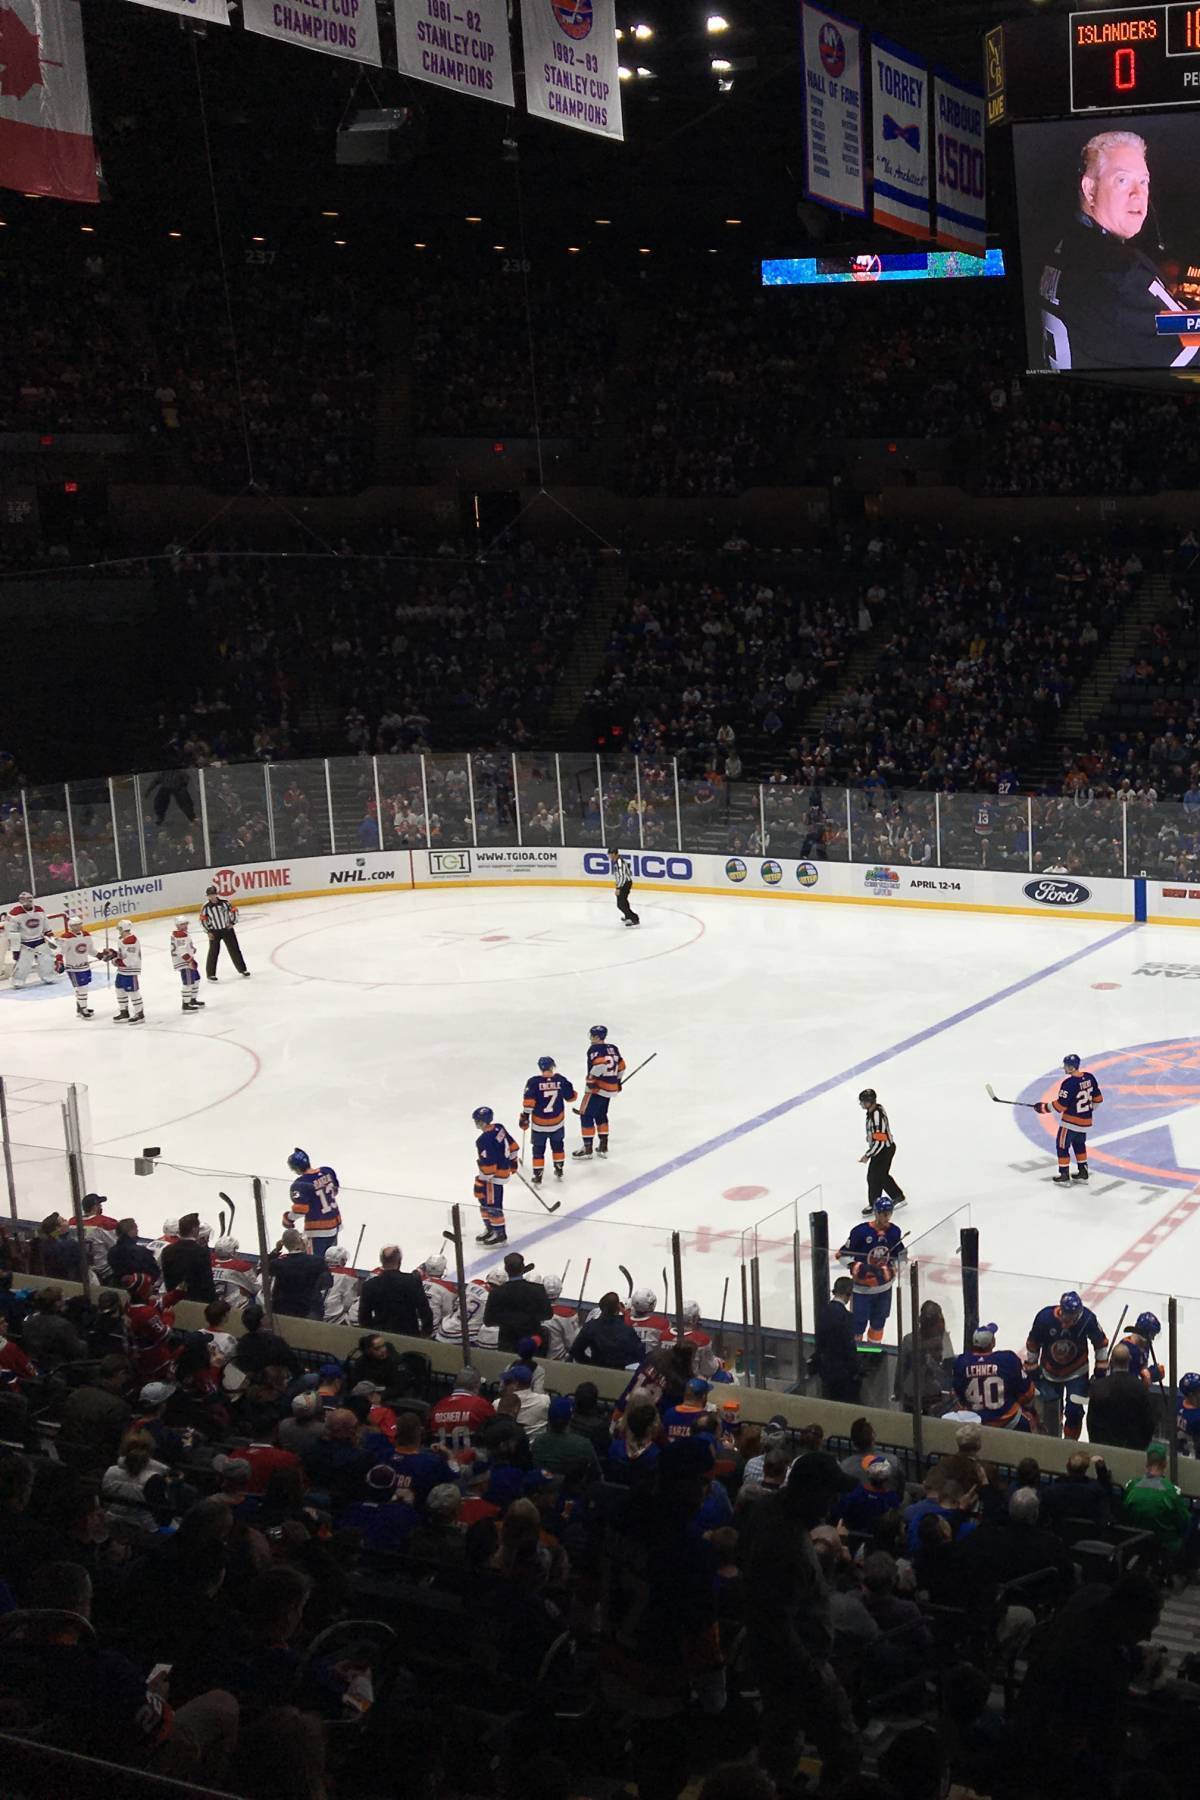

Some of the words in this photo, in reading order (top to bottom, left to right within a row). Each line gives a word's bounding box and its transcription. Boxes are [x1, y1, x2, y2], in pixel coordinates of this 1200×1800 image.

[272, 3, 357, 48] CHAMPIONS
[417, 20, 470, 58] STANLEY
[472, 38, 495, 64] CUP
[1077, 20, 1157, 44] ISLANDERS
[422, 50, 494, 90] CHAMPIONS
[543, 64, 588, 96] STANLEY
[589, 79, 610, 102] CUP
[877, 60, 923, 109] TORREY
[1115, 48, 1135, 90] 0
[548, 91, 608, 126] CHAMPIONS
[939, 92, 982, 137] ARBOUR
[937, 133, 985, 201] 1500
[476, 853, 558, 862] WWW.TGIOA.COM
[92, 879, 163, 902] Northwell
[329, 870, 395, 884] NHL.COM
[910, 880, 937, 889] APRIL
[939, 882, 961, 891] 12-14
[1035, 881, 1079, 902] Ford
[93, 900, 137, 919] Health
[544, 1090, 558, 1113] 7
[966, 1364, 998, 1378] LEHNER
[965, 1377, 1005, 1411] 40
